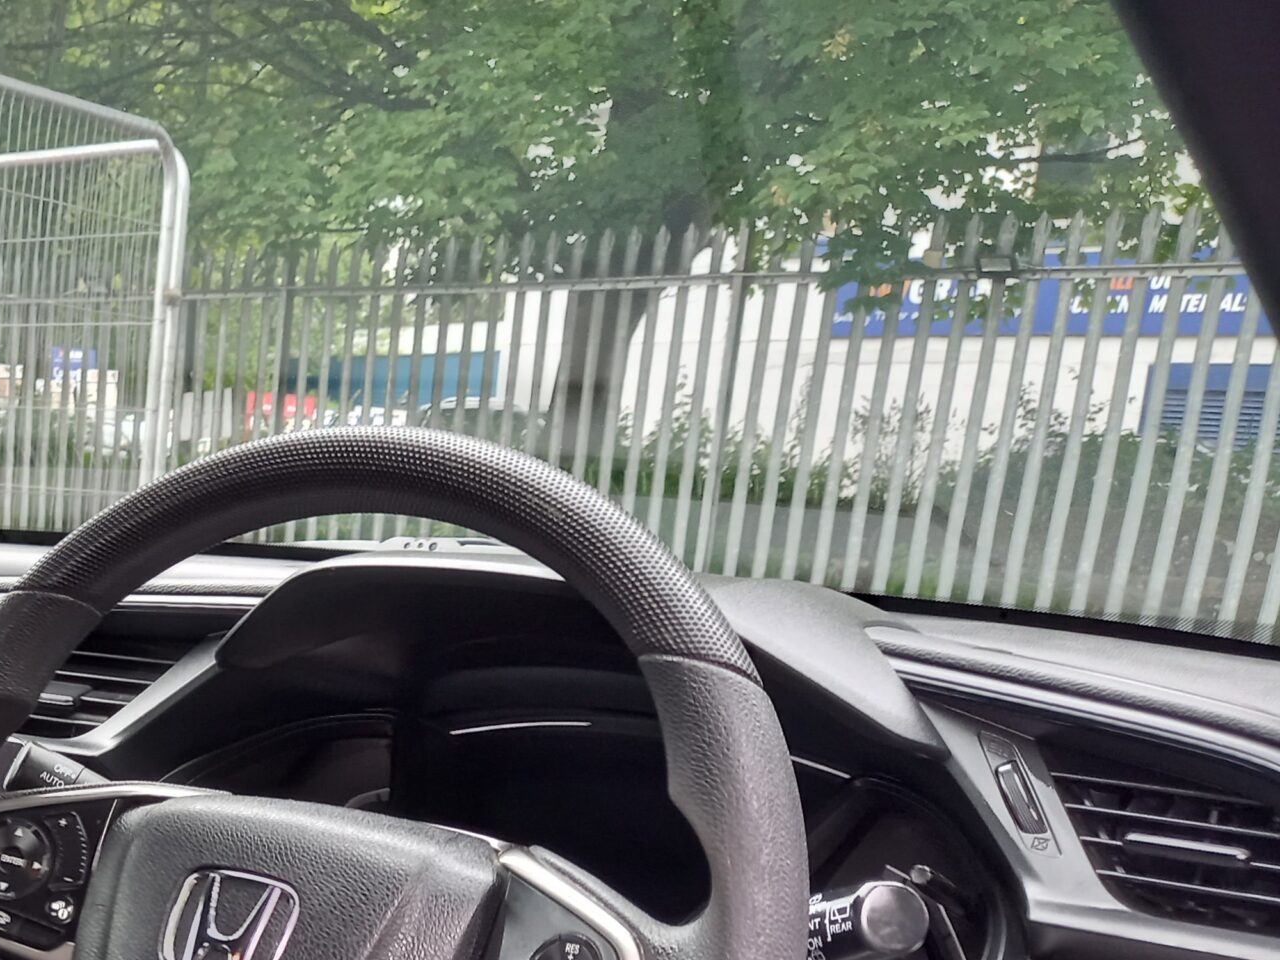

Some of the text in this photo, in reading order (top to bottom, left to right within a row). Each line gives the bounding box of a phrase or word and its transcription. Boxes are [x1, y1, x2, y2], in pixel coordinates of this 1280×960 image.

[53, 764, 72, 778] OFF
[39, 770, 65, 788] AUTO
[830, 921, 852, 935] REAR
[565, 942, 580, 955] RES
[807, 935, 824, 951] ON
